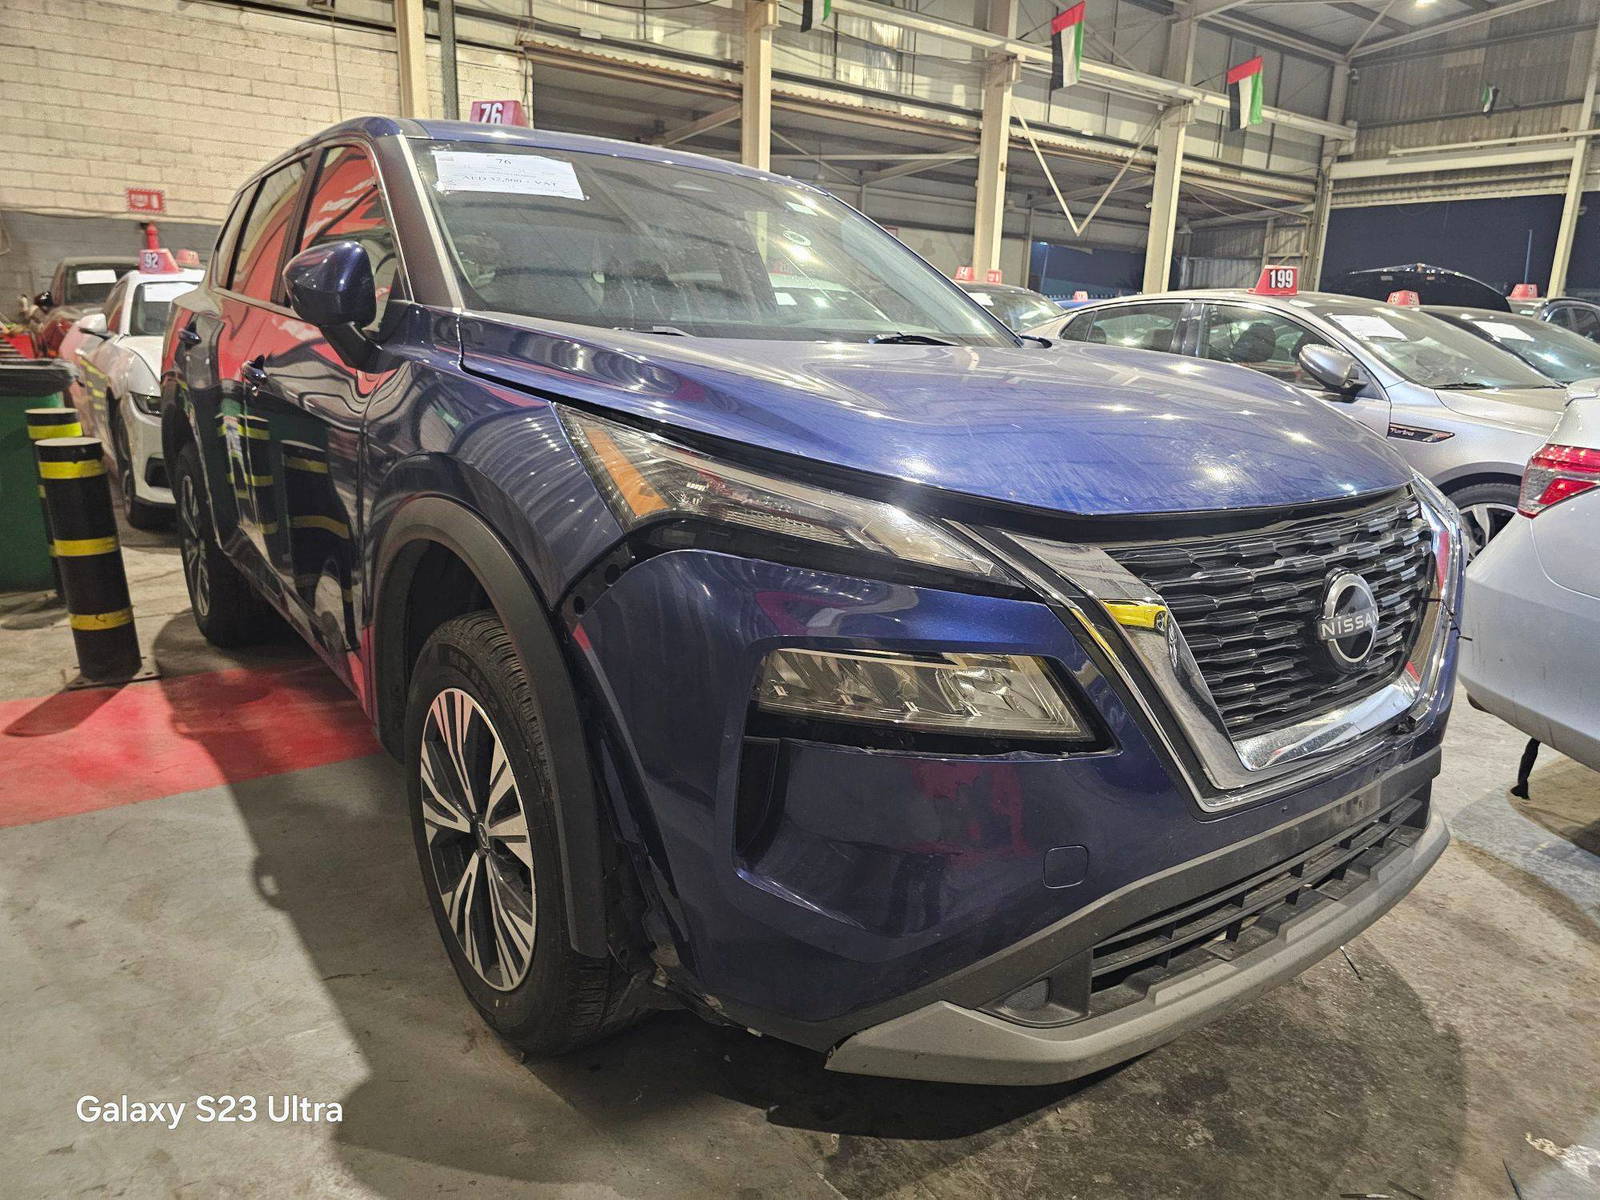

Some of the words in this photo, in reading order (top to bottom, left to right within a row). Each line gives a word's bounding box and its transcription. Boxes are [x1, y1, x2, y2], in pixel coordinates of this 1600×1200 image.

[481, 102, 503, 125] 76
[495, 158, 512, 166] 76
[144, 252, 159, 269] 92
[1270, 269, 1294, 289] 199
[1321, 609, 1379, 637] NISSAN
